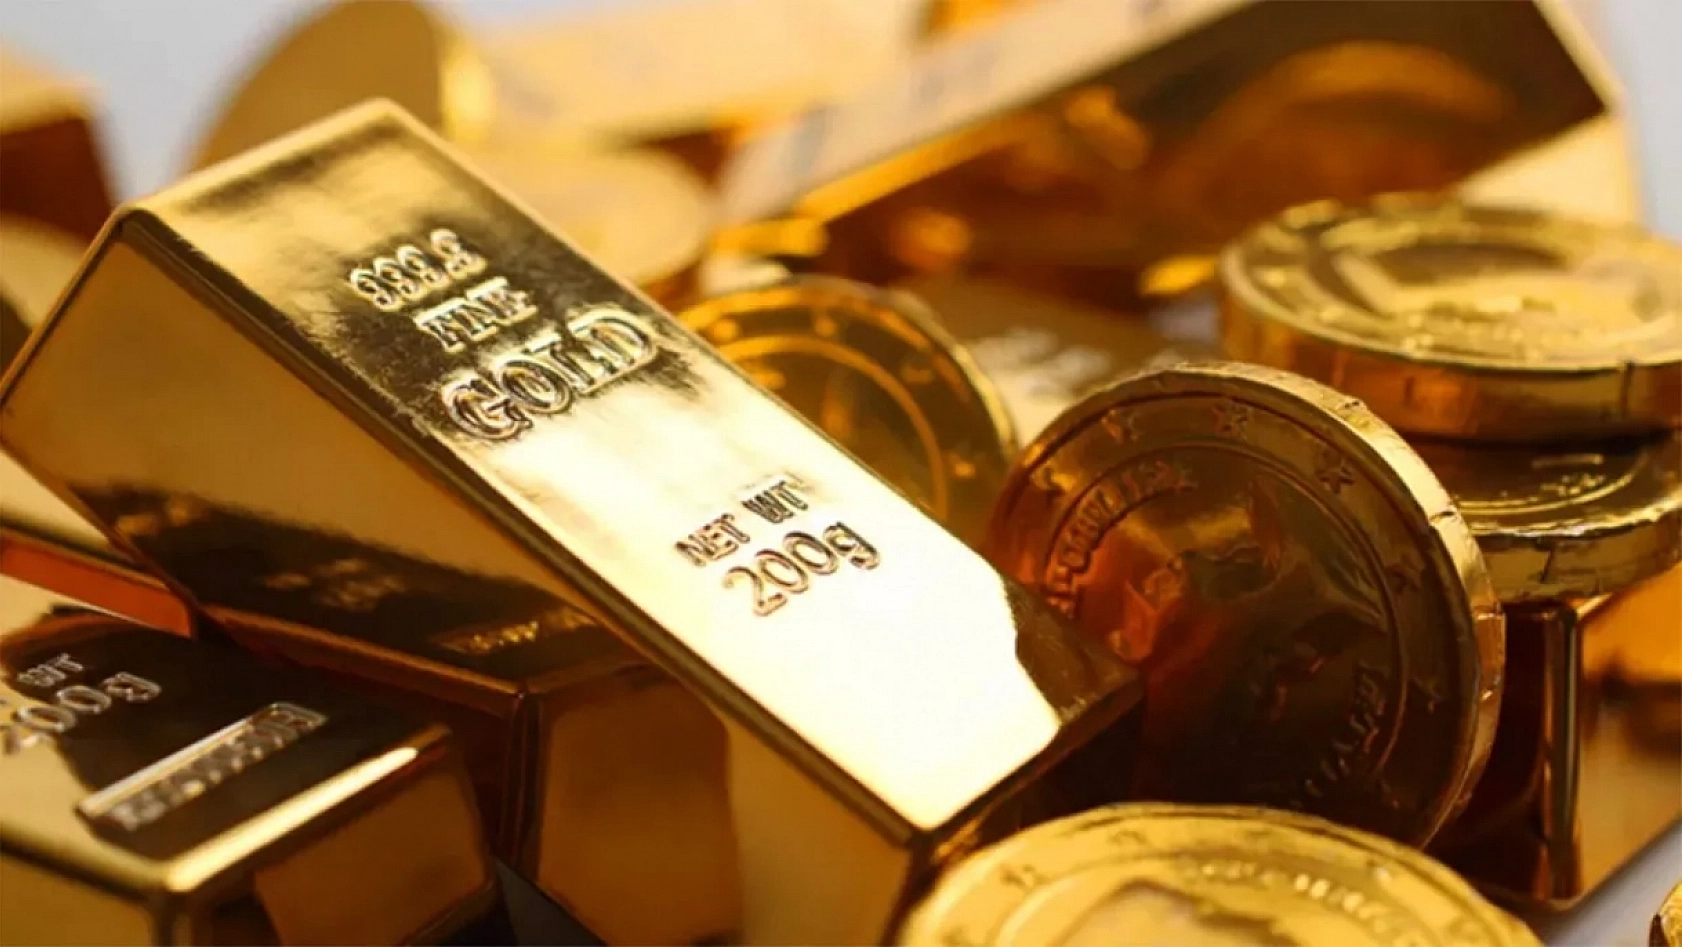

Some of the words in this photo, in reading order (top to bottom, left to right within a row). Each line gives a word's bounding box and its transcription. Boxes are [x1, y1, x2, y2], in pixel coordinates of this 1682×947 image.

[412, 275, 538, 354] FINE
[441, 305, 661, 442] GOLD
[674, 512, 752, 568] NET
[740, 479, 809, 524] WT
[721, 520, 882, 617] 200g
